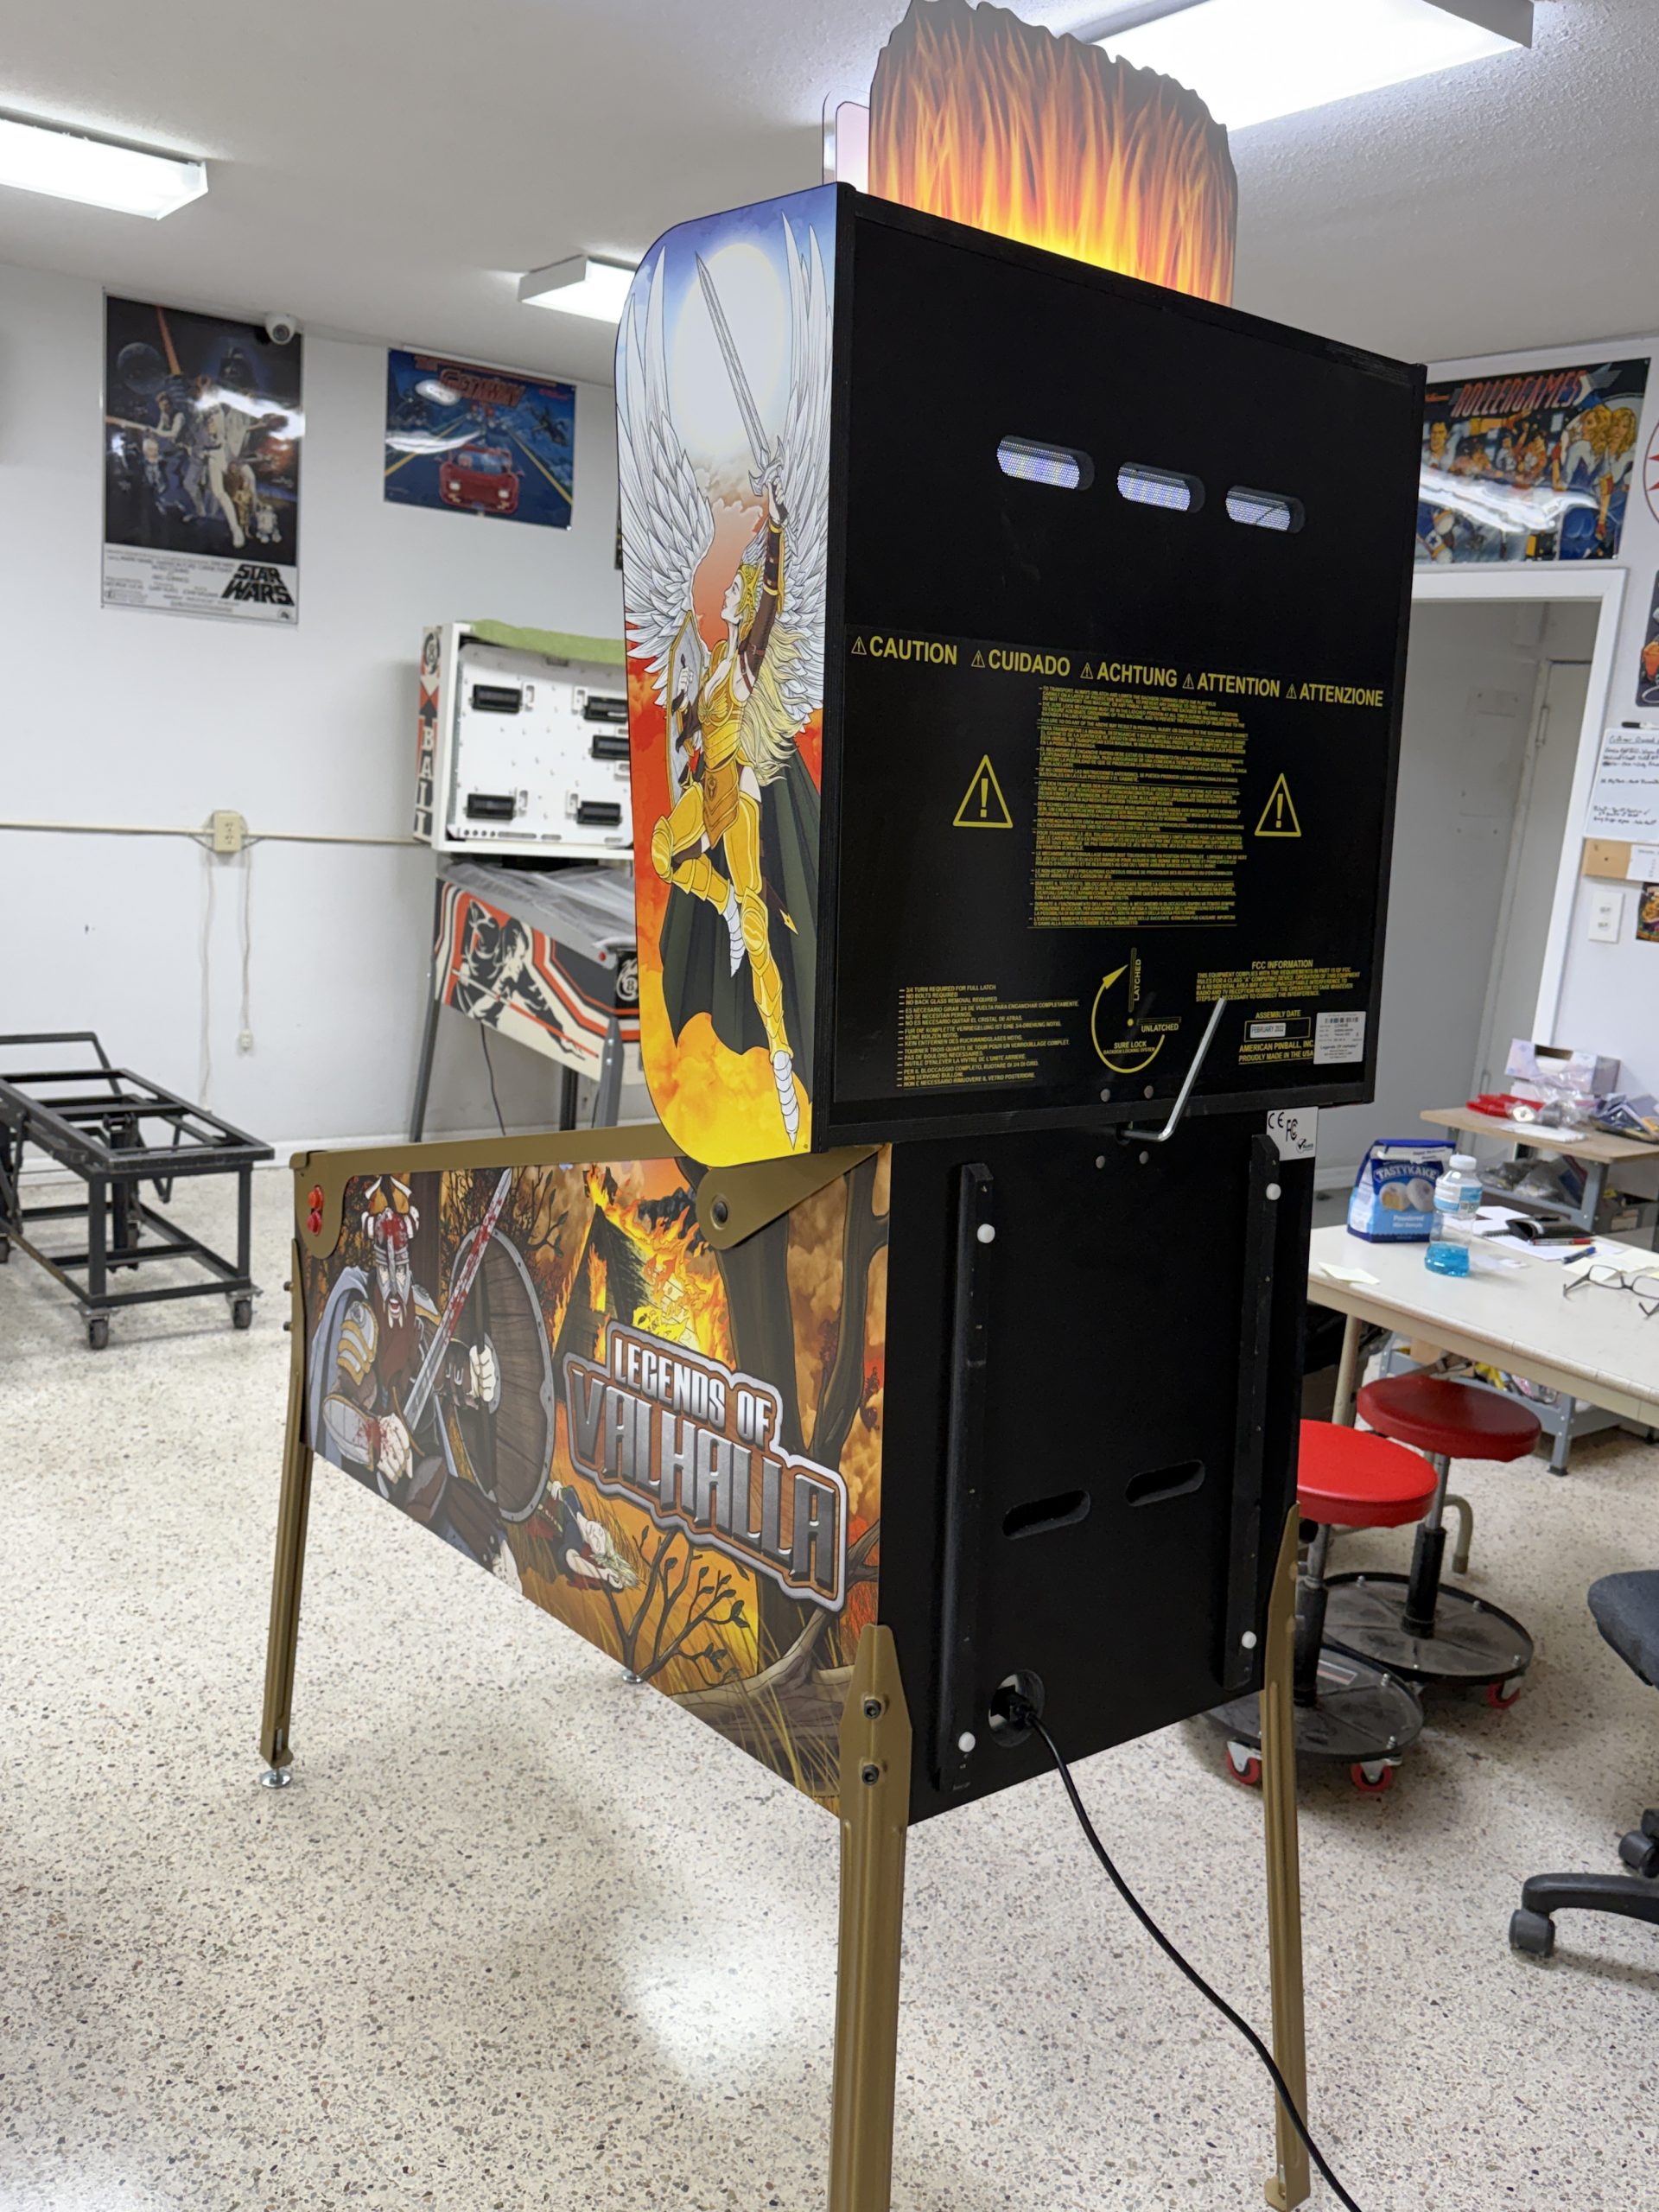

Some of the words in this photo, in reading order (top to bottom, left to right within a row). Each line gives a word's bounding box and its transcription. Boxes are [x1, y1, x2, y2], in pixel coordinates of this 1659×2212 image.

[233, 563, 284, 585] STAR
[221, 580, 296, 607] WARS
[869, 635, 957, 665] CAUTION
[988, 649, 1071, 677] CUIDADO
[1096, 662, 1178, 688] ACHTUNG
[1197, 673, 1280, 697] ATTENTION
[1300, 683, 1384, 708] ATTENZIONE
[1252, 960, 1267, 969] FCC
[1267, 959, 1313, 969] INFORMATION
[1255, 1011, 1285, 1019] ASSEMBLY
[1286, 1009, 1301, 1017] DATE
[1141, 1023, 1179, 1033] UNLATCHED
[1131, 1040, 1147, 1048] LOCK
[1239, 1043, 1273, 1052] AMERICAN
[1238, 1053, 1266, 1062] PROUDLY
[1266, 1052, 1283, 1060] MADE
[1302, 1049, 1313, 1057] USA
[1268, 1112, 1284, 1129] CE
[1376, 1165, 1437, 1180] TASTYKAKE
[613, 1337, 727, 1433] LEGENDS
[737, 1389, 774, 1451] OF
[570, 1368, 838, 1592] VALHALLA
